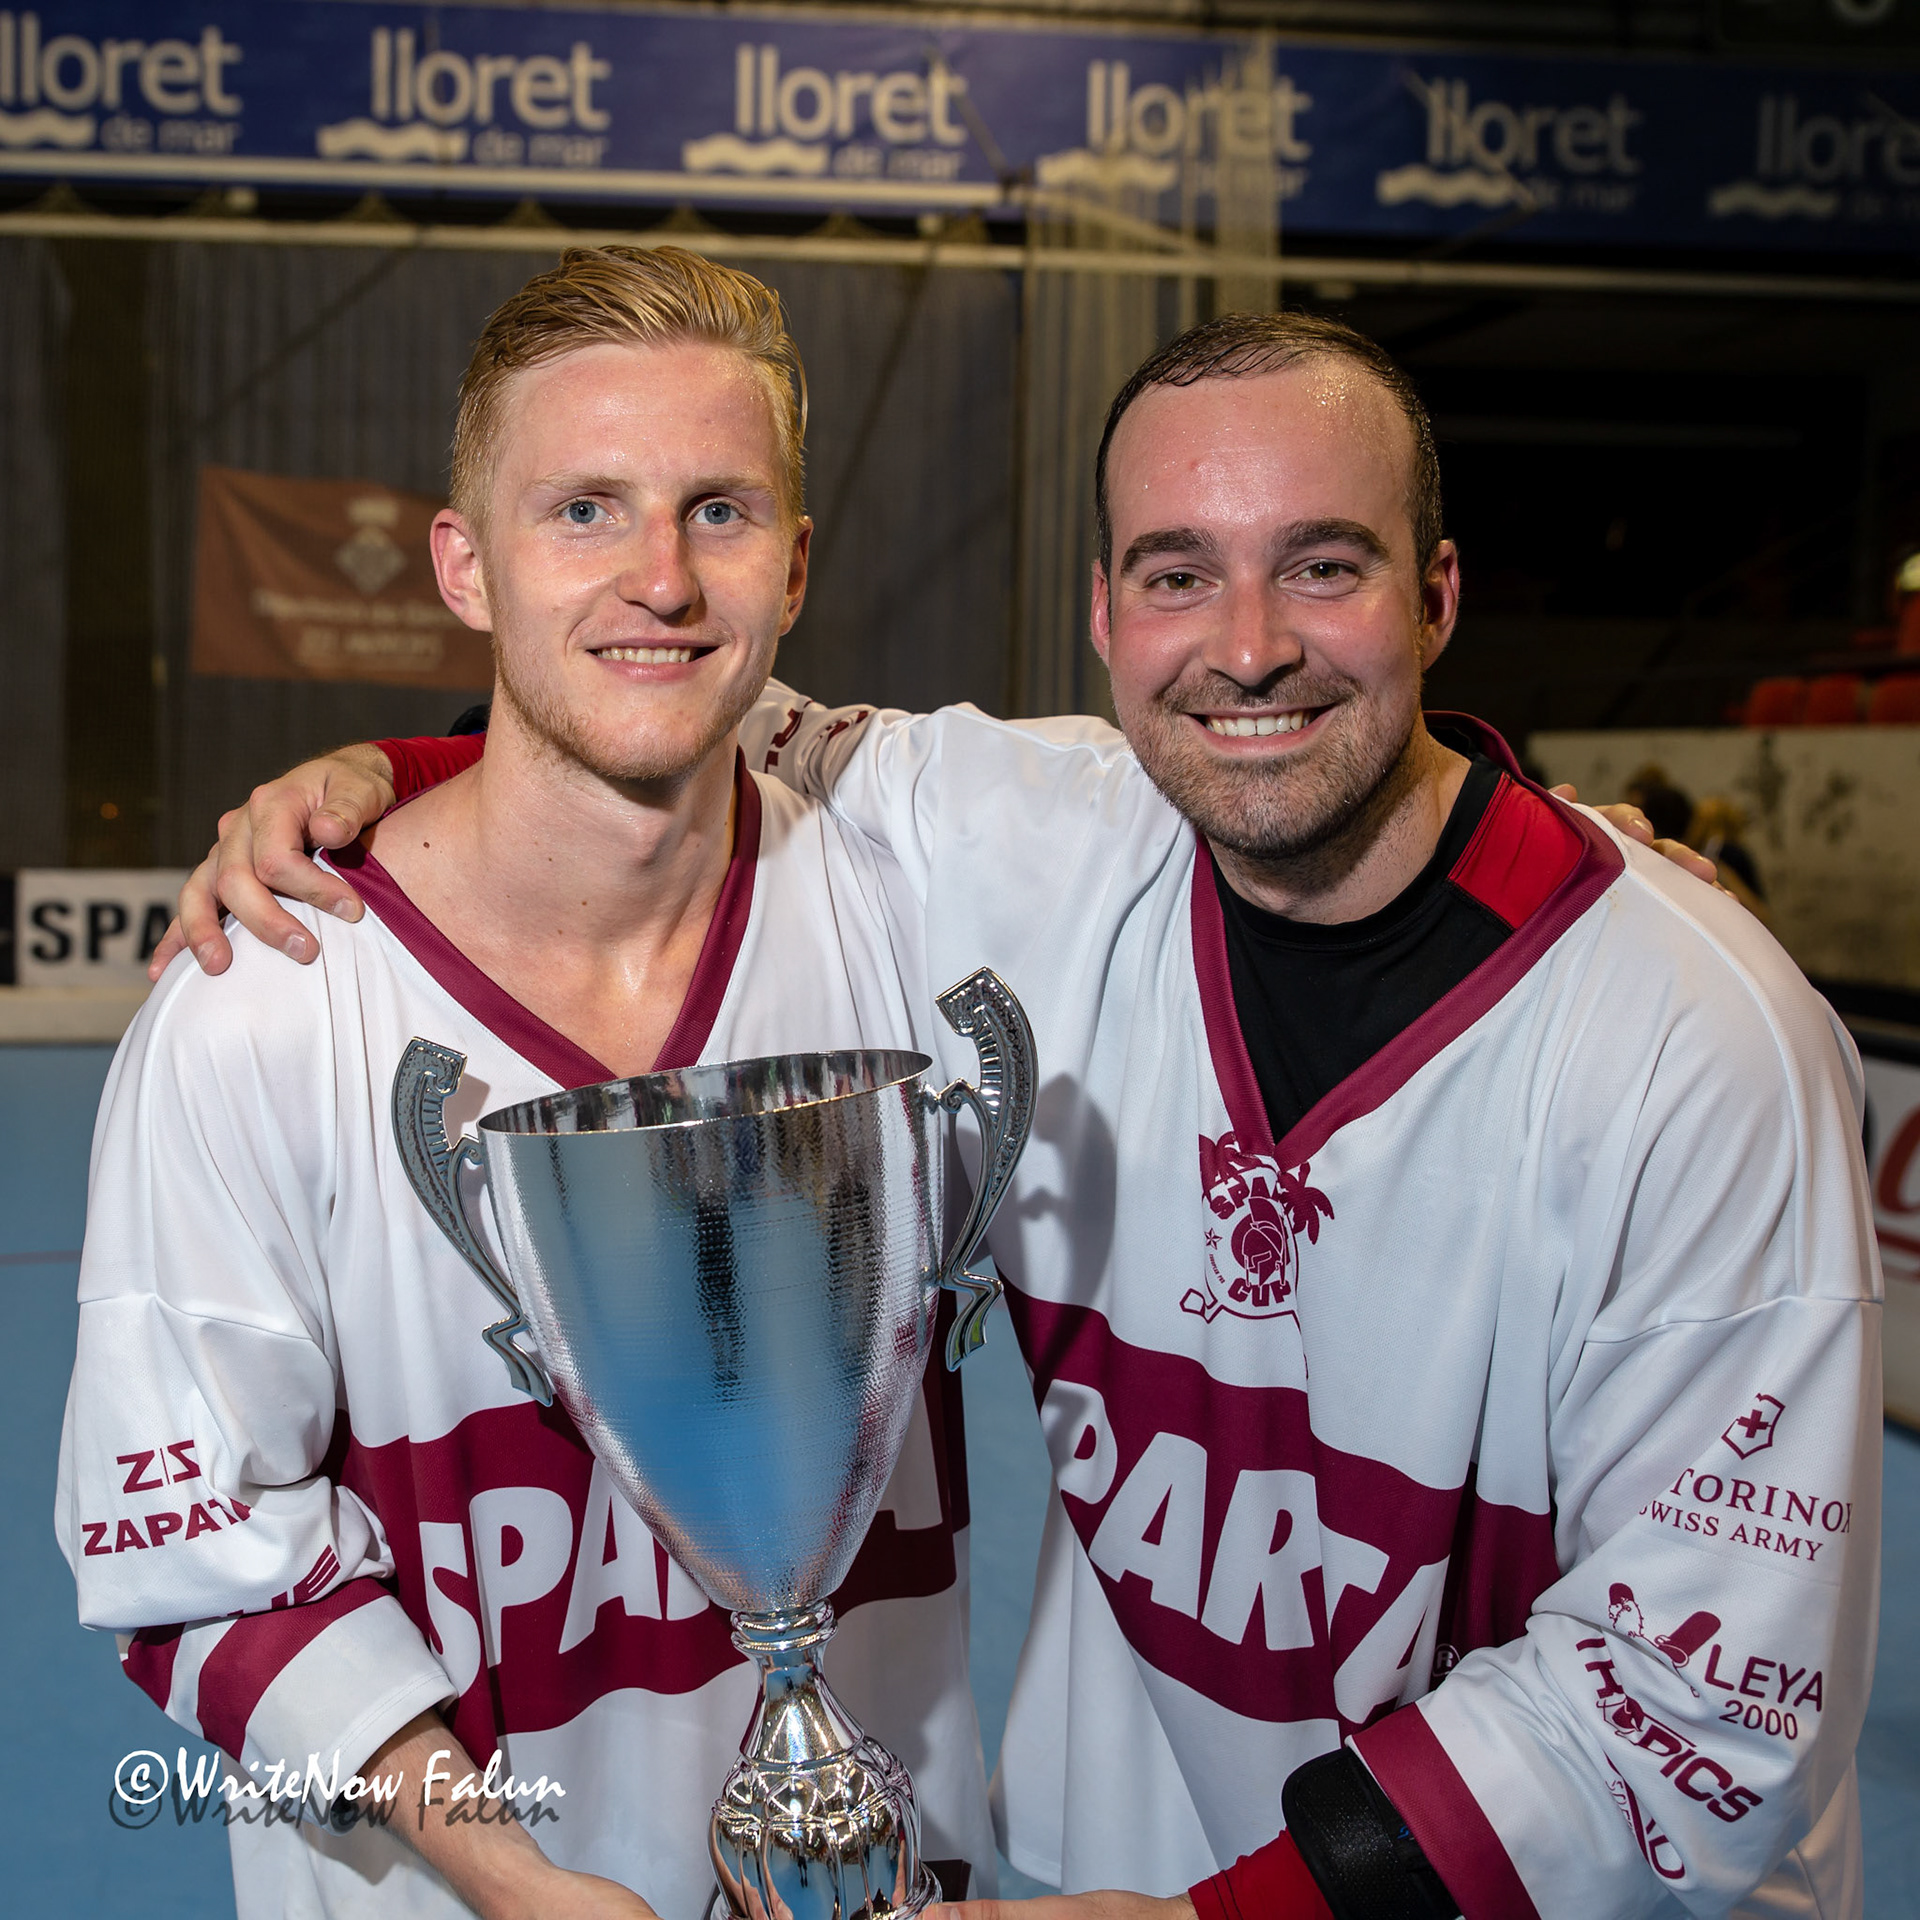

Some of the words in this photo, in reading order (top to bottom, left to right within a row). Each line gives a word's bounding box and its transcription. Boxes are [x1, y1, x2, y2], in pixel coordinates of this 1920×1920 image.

[0, 11, 243, 116] lloret
[371, 26, 612, 131] lloret
[735, 43, 968, 146] lloret
[1088, 59, 1314, 163] lloret
[1426, 78, 1647, 176] lloret
[1227, 1277, 1292, 1307] CUP
[1729, 1522, 1824, 1562] ARMY
[1704, 1643, 1823, 1713] LEYA
[1718, 1699, 1799, 1740] 2000
